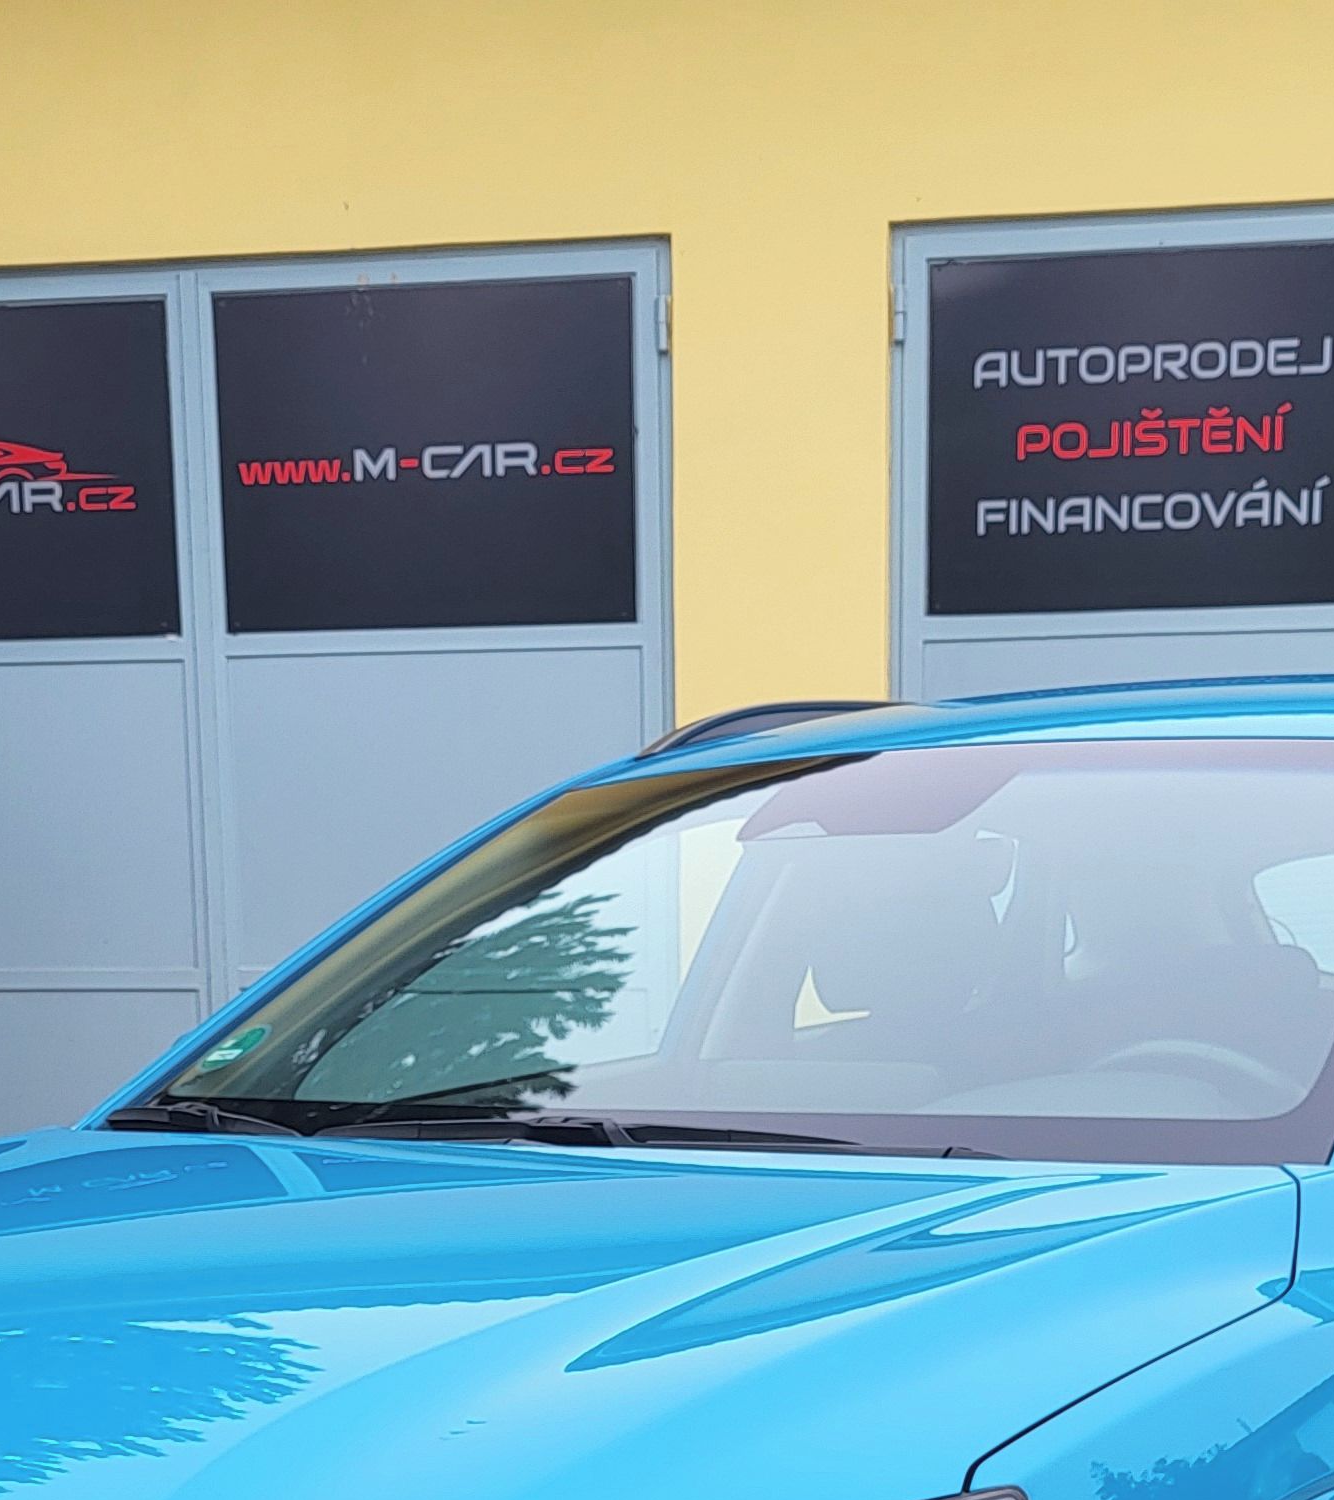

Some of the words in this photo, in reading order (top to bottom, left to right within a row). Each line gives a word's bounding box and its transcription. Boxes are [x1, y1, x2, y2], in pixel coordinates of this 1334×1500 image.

[973, 335, 1333, 390] AUTOPRODEJ
[1015, 402, 1292, 461] POJIŠTĚNÍ
[975, 475, 1331, 537] FINANCOVÁNÍ
